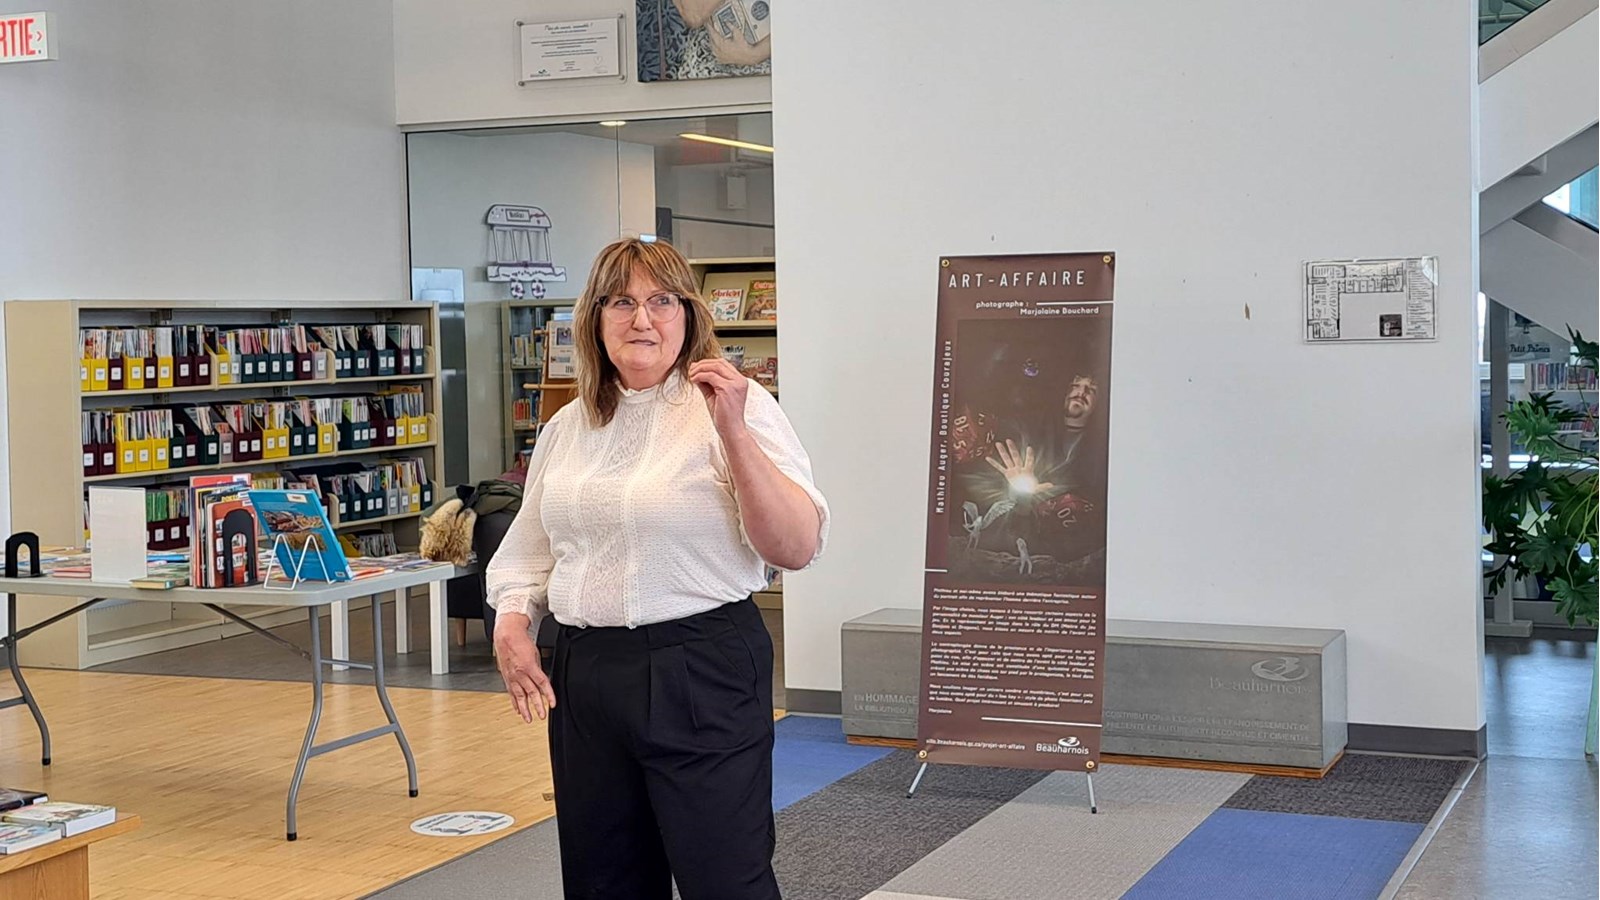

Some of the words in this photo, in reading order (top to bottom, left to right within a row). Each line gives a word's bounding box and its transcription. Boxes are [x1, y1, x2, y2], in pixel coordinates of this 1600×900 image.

[949, 270, 1085, 288] ART-AFFAIRE
[975, 300, 1024, 309] photographe
[1020, 307, 1060, 317] Marjolaine
[1062, 306, 1099, 315] Bouchard
[941, 340, 952, 388] Courajeux
[939, 392, 950, 436] Boutique
[936, 475, 946, 514] Mathieu
[866, 693, 919, 705] HOMMAGE
